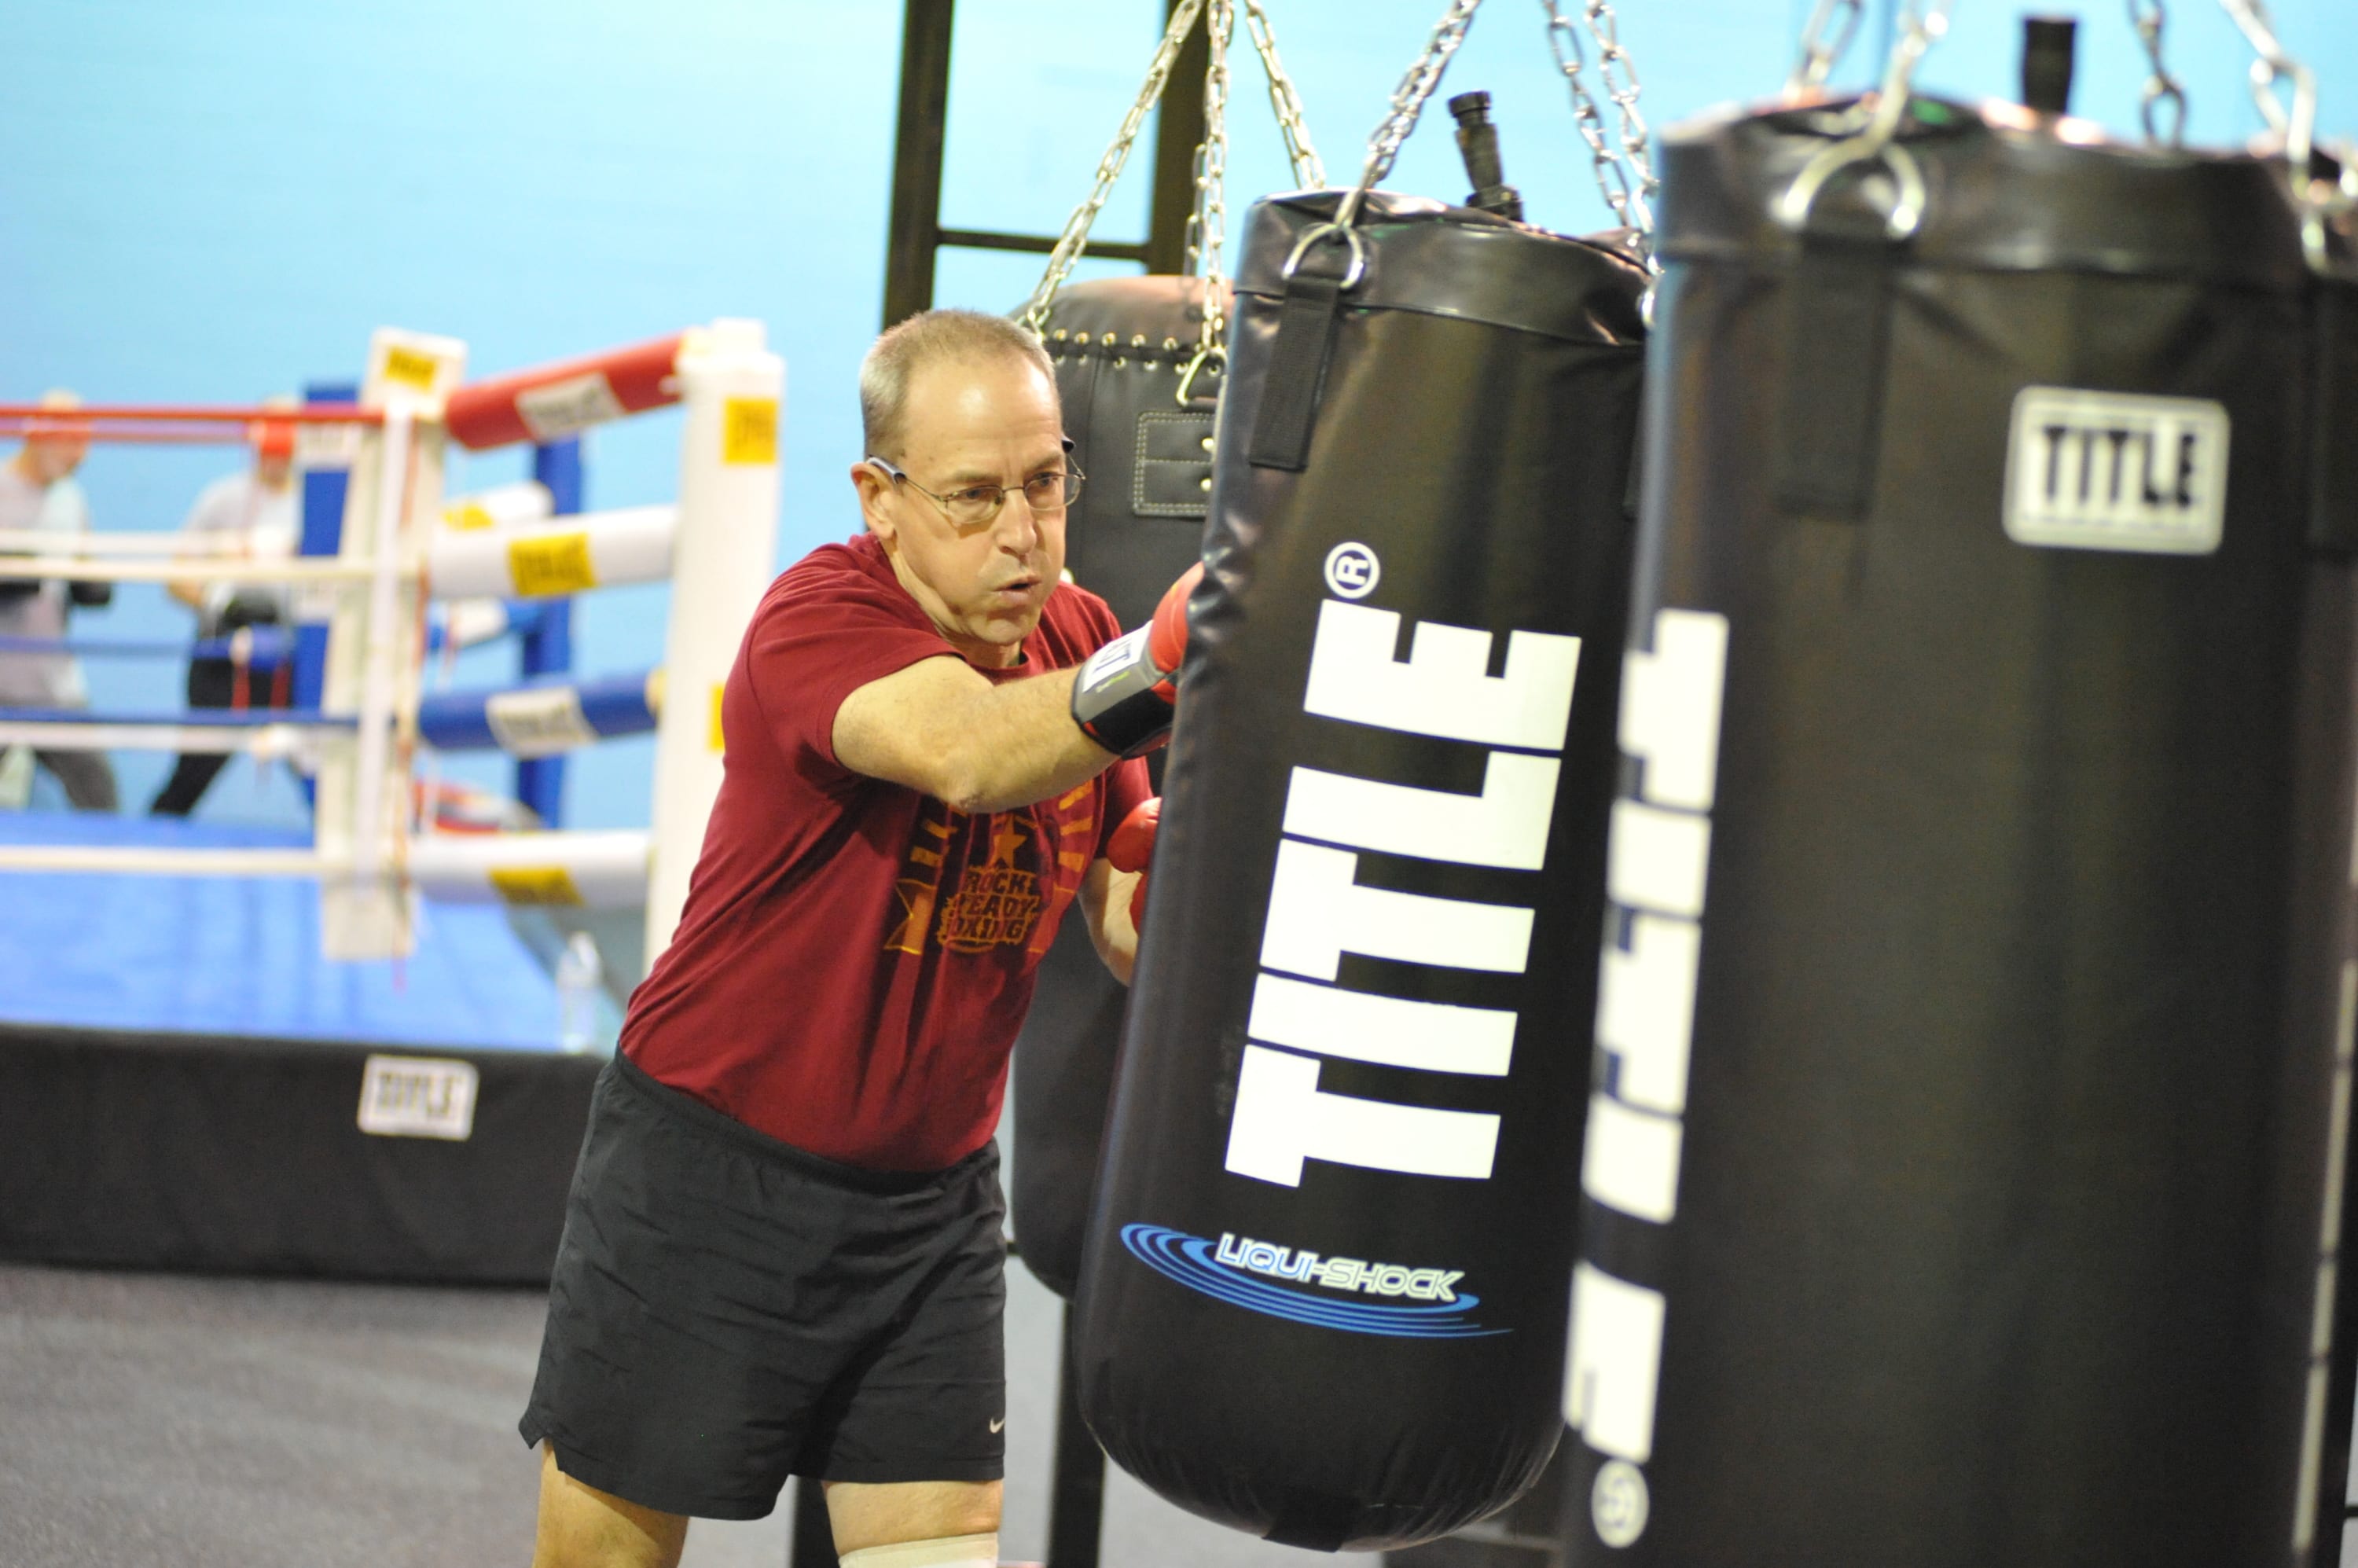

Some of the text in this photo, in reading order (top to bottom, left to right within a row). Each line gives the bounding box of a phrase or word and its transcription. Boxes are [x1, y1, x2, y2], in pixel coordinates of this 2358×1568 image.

[2040, 424, 2201, 510] TITLE
[942, 916, 1024, 940] OXING
[948, 894, 1038, 918] TEADY
[1224, 600, 1581, 1187] TITLE
[1214, 1232, 1464, 1302] LIQUI-SHOCK
